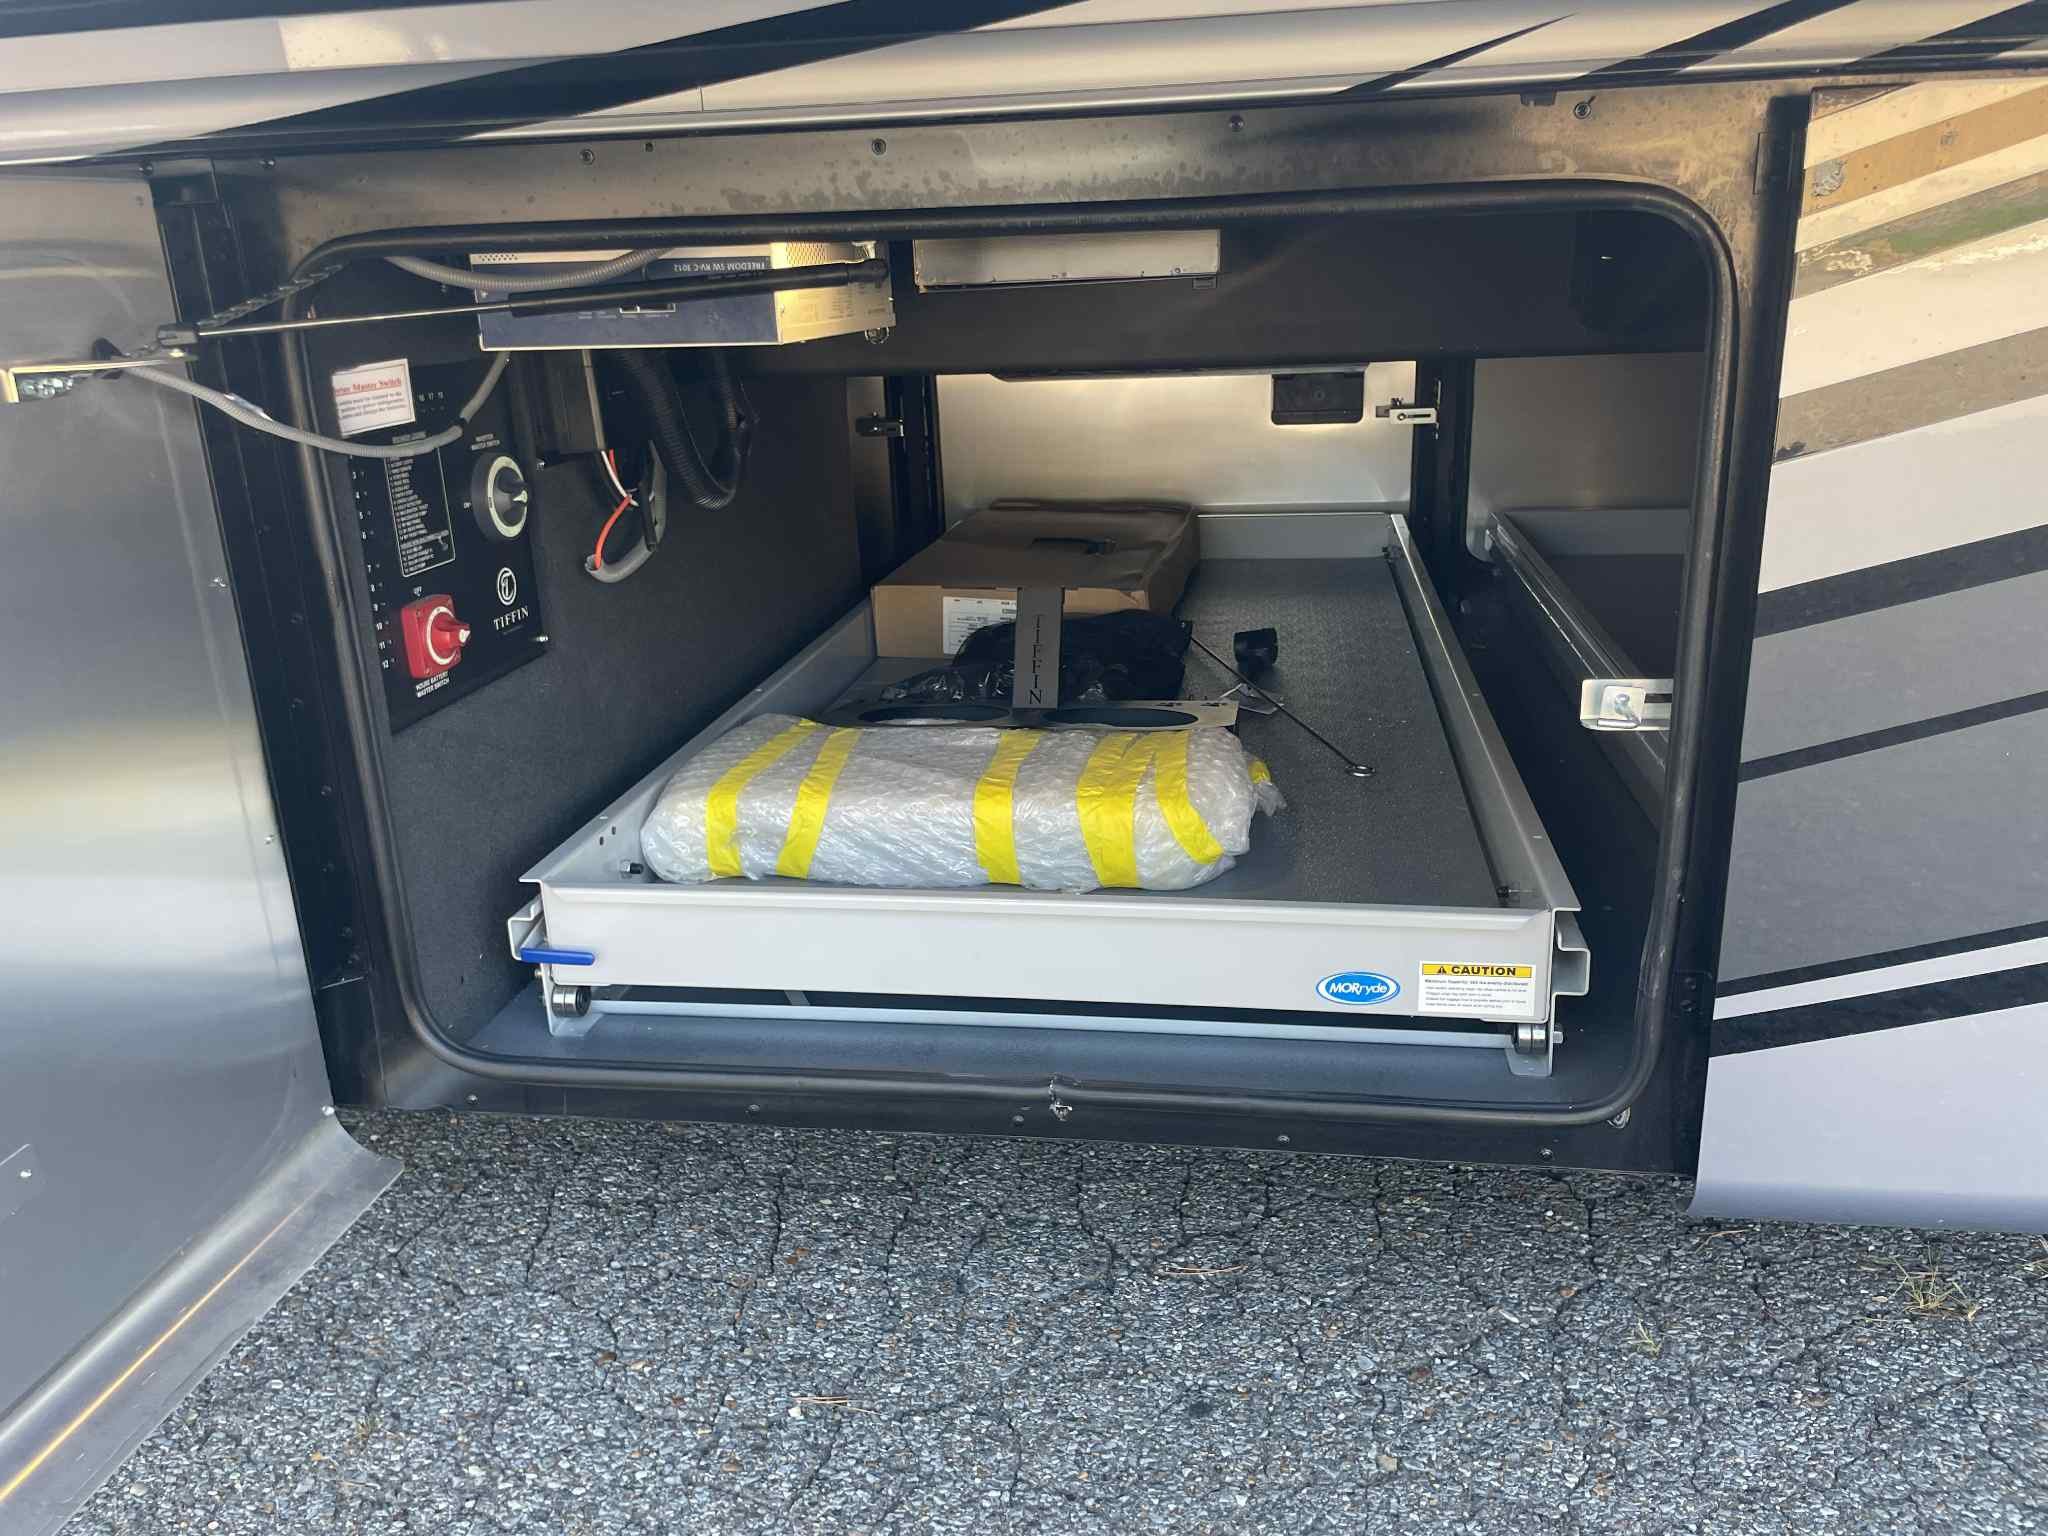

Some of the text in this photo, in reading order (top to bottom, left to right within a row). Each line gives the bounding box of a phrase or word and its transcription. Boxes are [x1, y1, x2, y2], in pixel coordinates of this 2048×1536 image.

[493, 605, 529, 631] TIFFIN
[1029, 614, 1044, 705] TIFFIN
[416, 677, 450, 698] MASTER SWITCH
[430, 671, 449, 684] BATTERY
[1451, 965, 1516, 976] CAUTION
